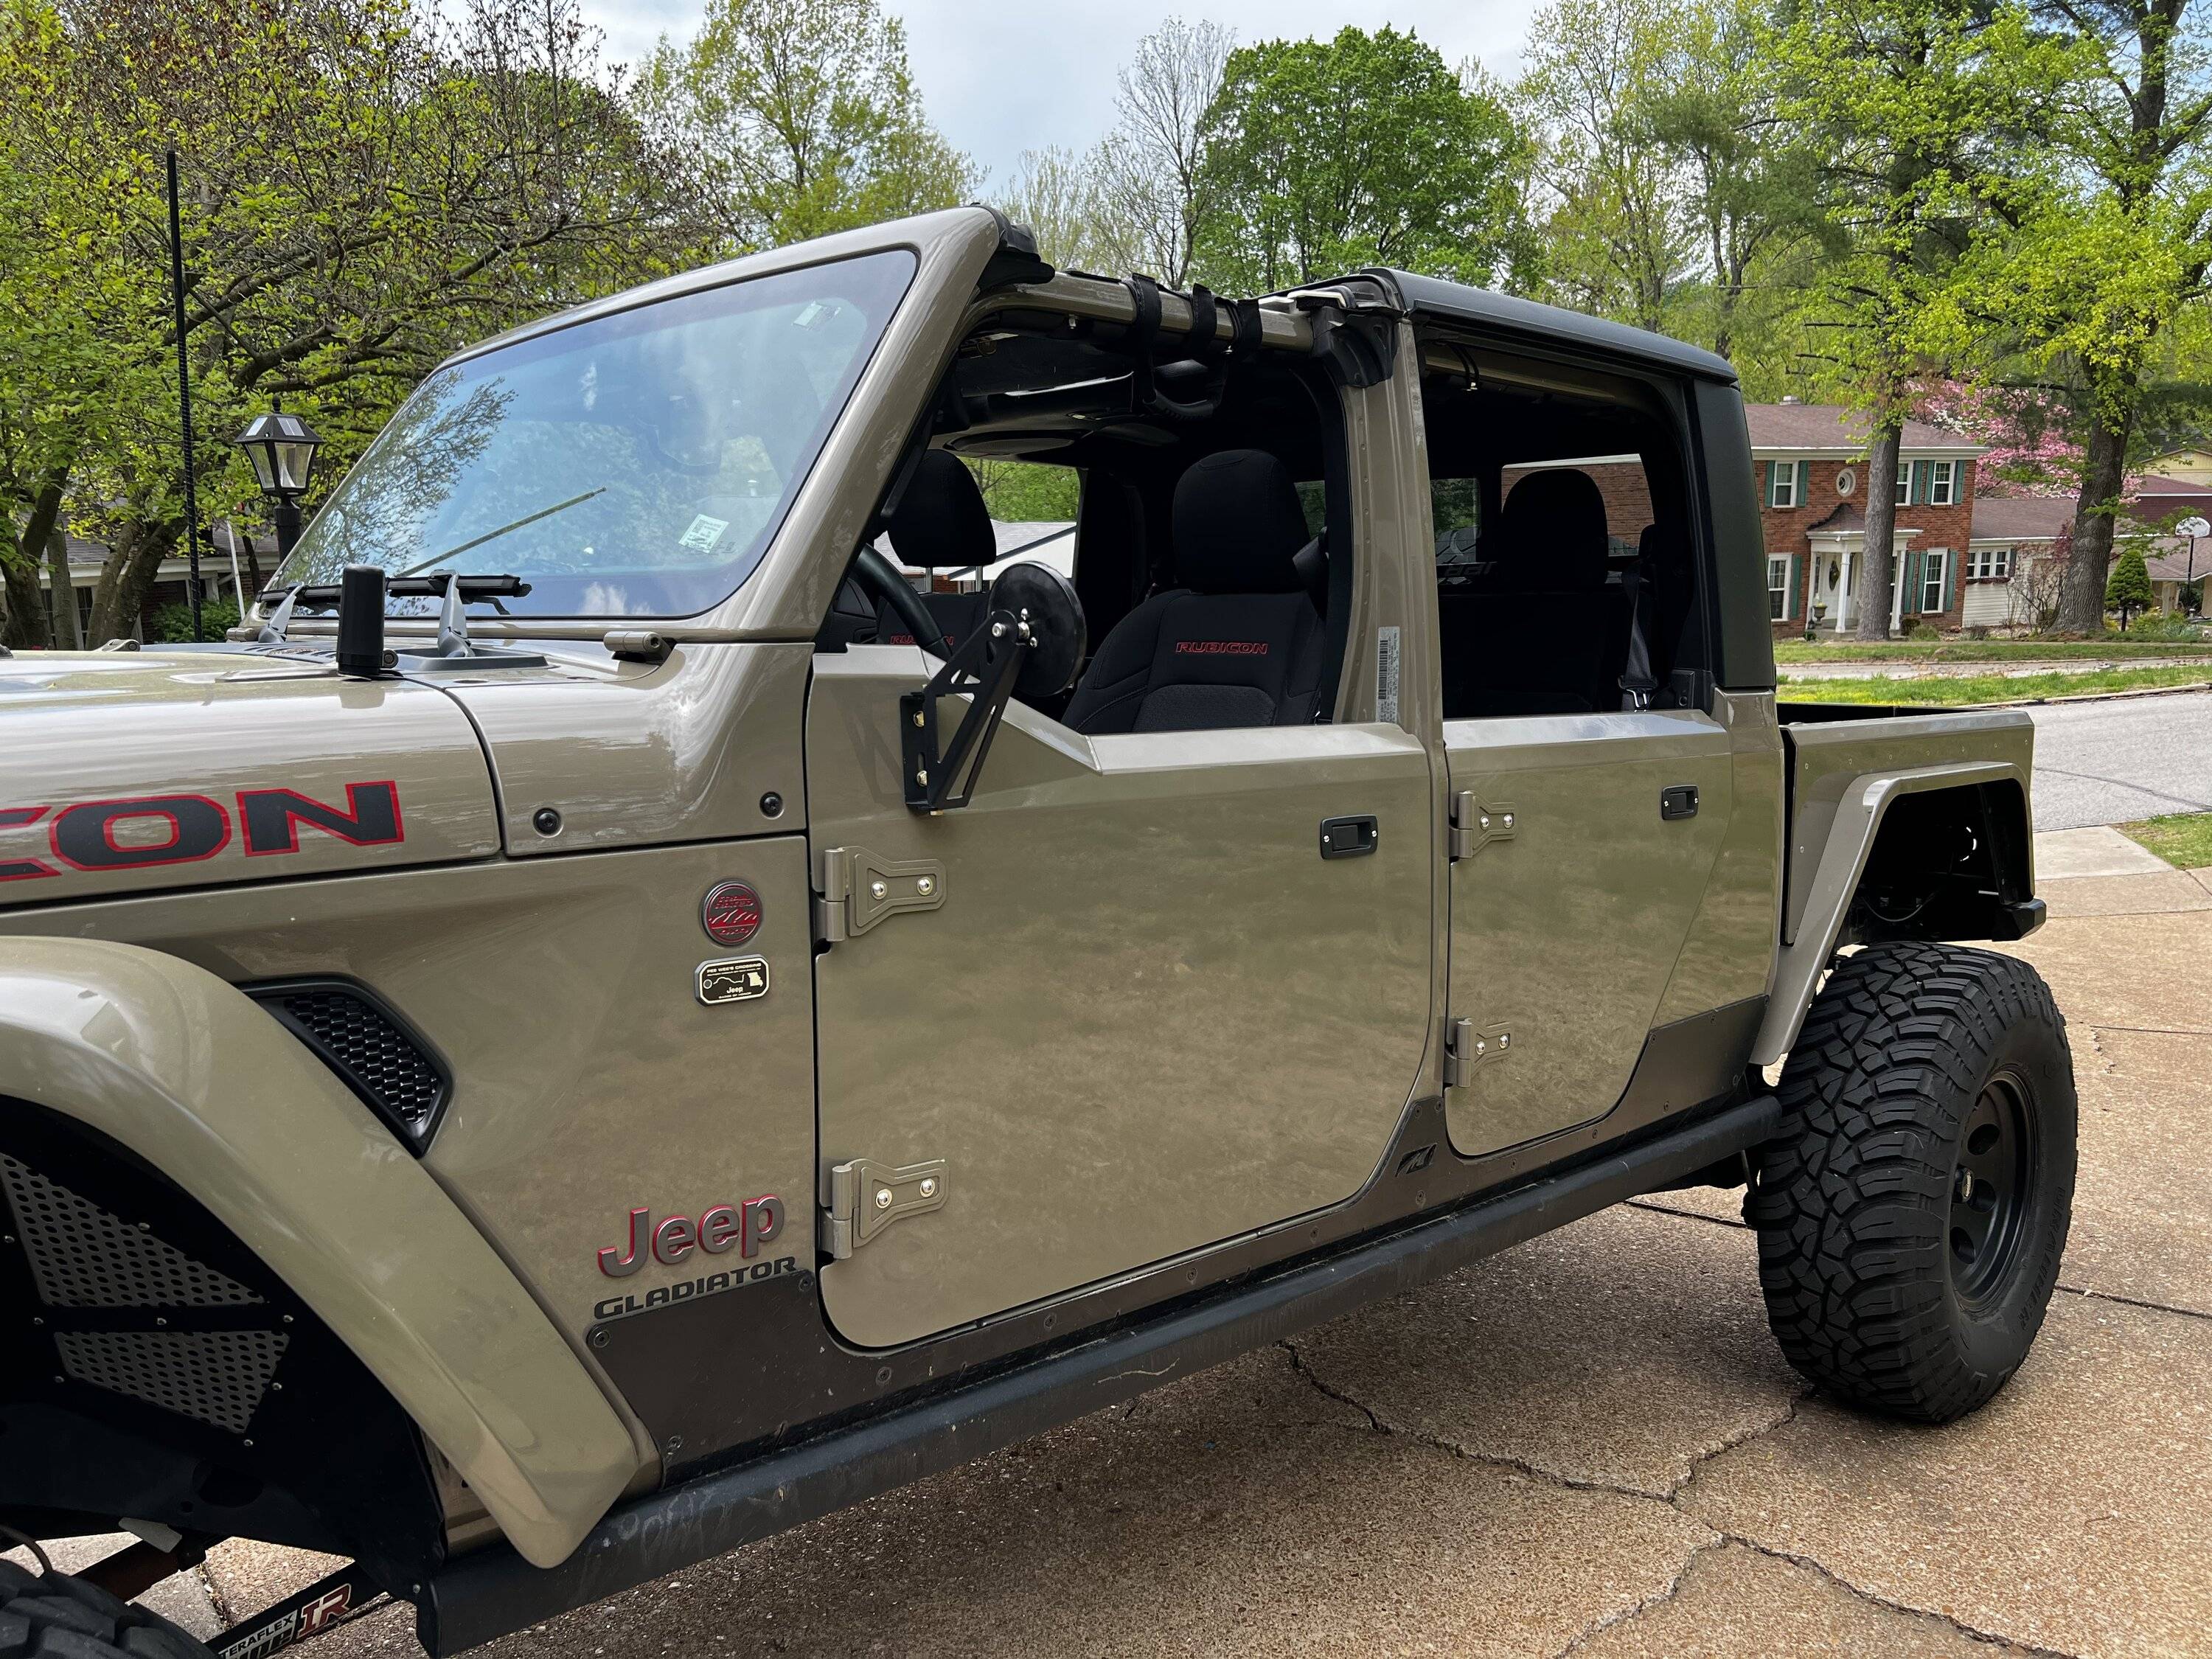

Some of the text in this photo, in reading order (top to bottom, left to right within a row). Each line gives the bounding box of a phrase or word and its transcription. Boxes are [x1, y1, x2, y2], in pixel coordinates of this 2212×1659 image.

[1175, 641, 1269, 655] RUBICON
[597, 1193, 785, 1277] Jeep
[594, 1256, 797, 1320] GLADIATOR
[220, 1614, 293, 1658] TERAFLEX
[296, 1583, 352, 1639] IR
